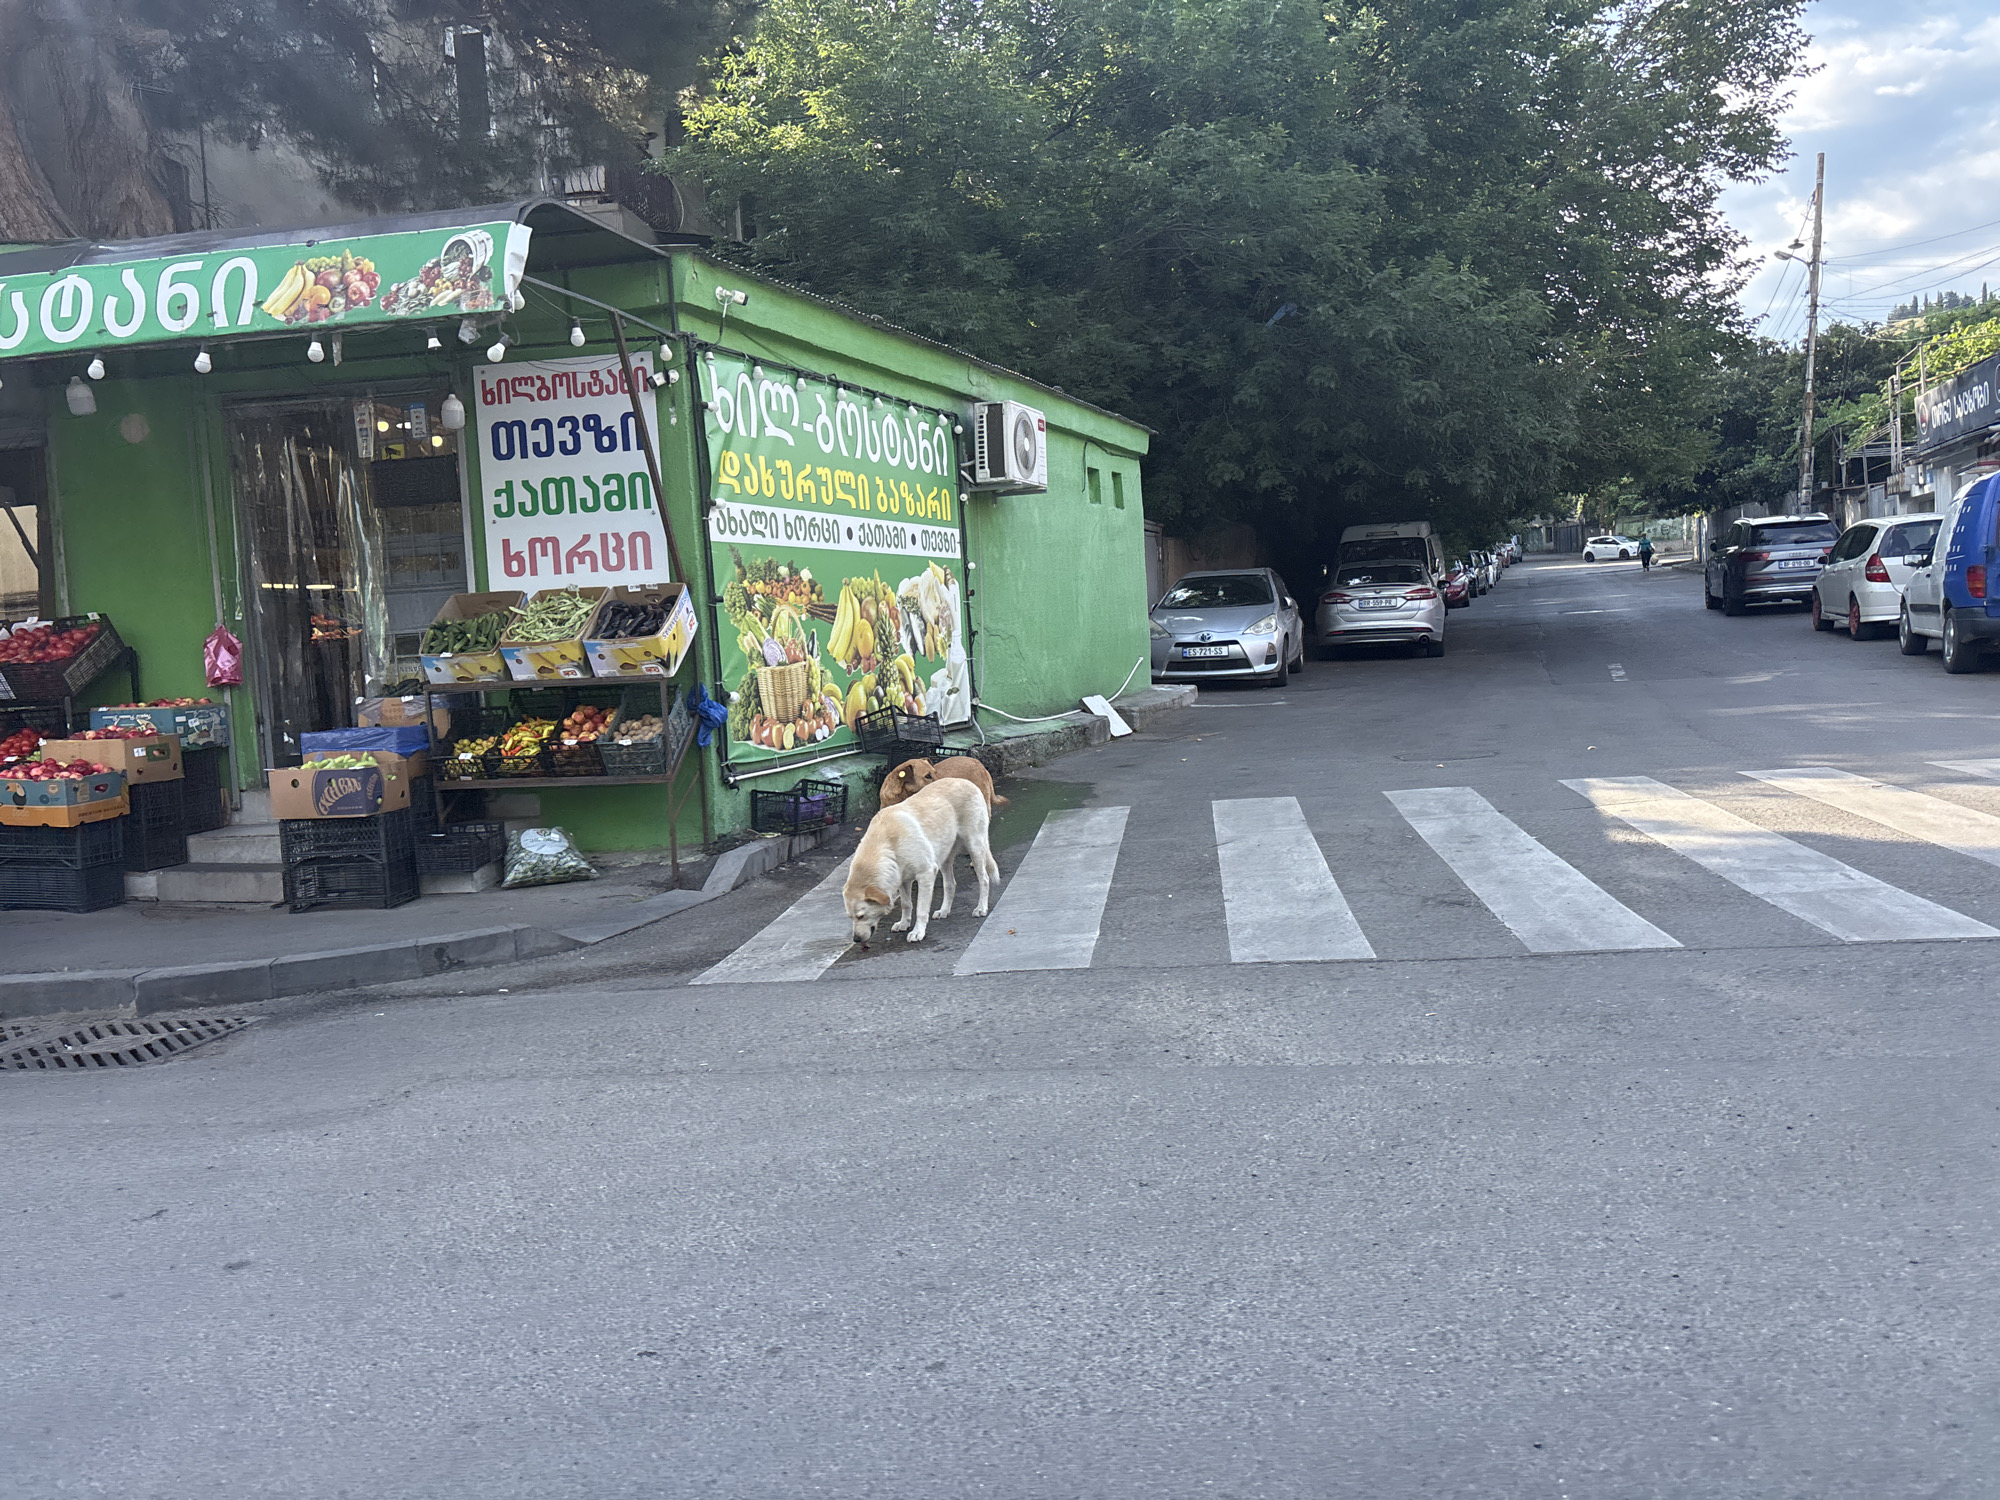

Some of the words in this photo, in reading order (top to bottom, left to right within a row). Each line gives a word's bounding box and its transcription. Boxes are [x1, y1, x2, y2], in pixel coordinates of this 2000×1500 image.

[491, 411, 645, 461] თევზი
[708, 363, 949, 477] ხილ-ბოსტანი
[493, 471, 652, 518] ქათამი
[718, 449, 872, 512] დახურული
[875, 475, 952, 521] ბაზარი
[716, 507, 779, 539] ახალი
[783, 513, 840, 544] ხორცი
[858, 523, 907, 549] ქათამი
[920, 529, 957, 553] თევზი
[501, 531, 653, 578] ხორცი
[1188, 647, 1223, 656] ES-721-SS
